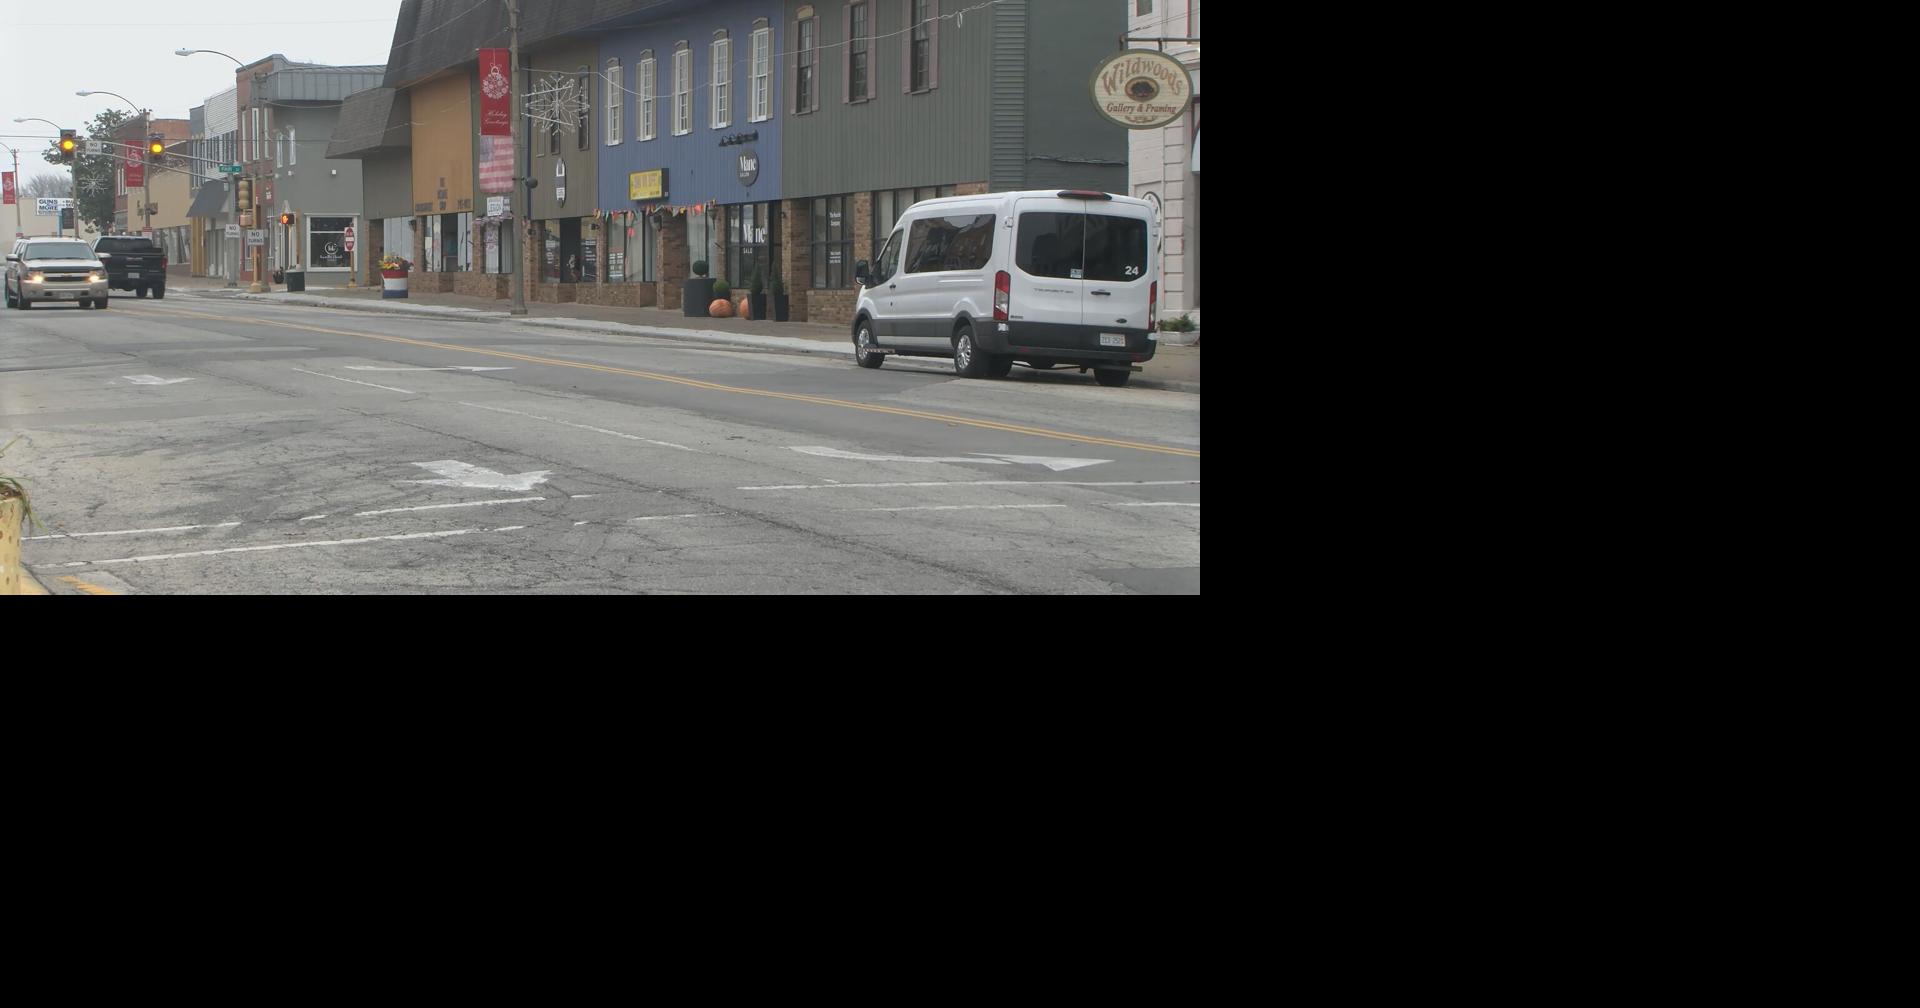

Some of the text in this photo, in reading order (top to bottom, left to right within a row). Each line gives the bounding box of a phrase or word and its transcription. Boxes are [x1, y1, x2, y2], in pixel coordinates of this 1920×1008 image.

[1102, 57, 1182, 95] Wildwoods
[1106, 103, 1177, 114] Gallery & Framing
[1125, 265, 1139, 275] 24
